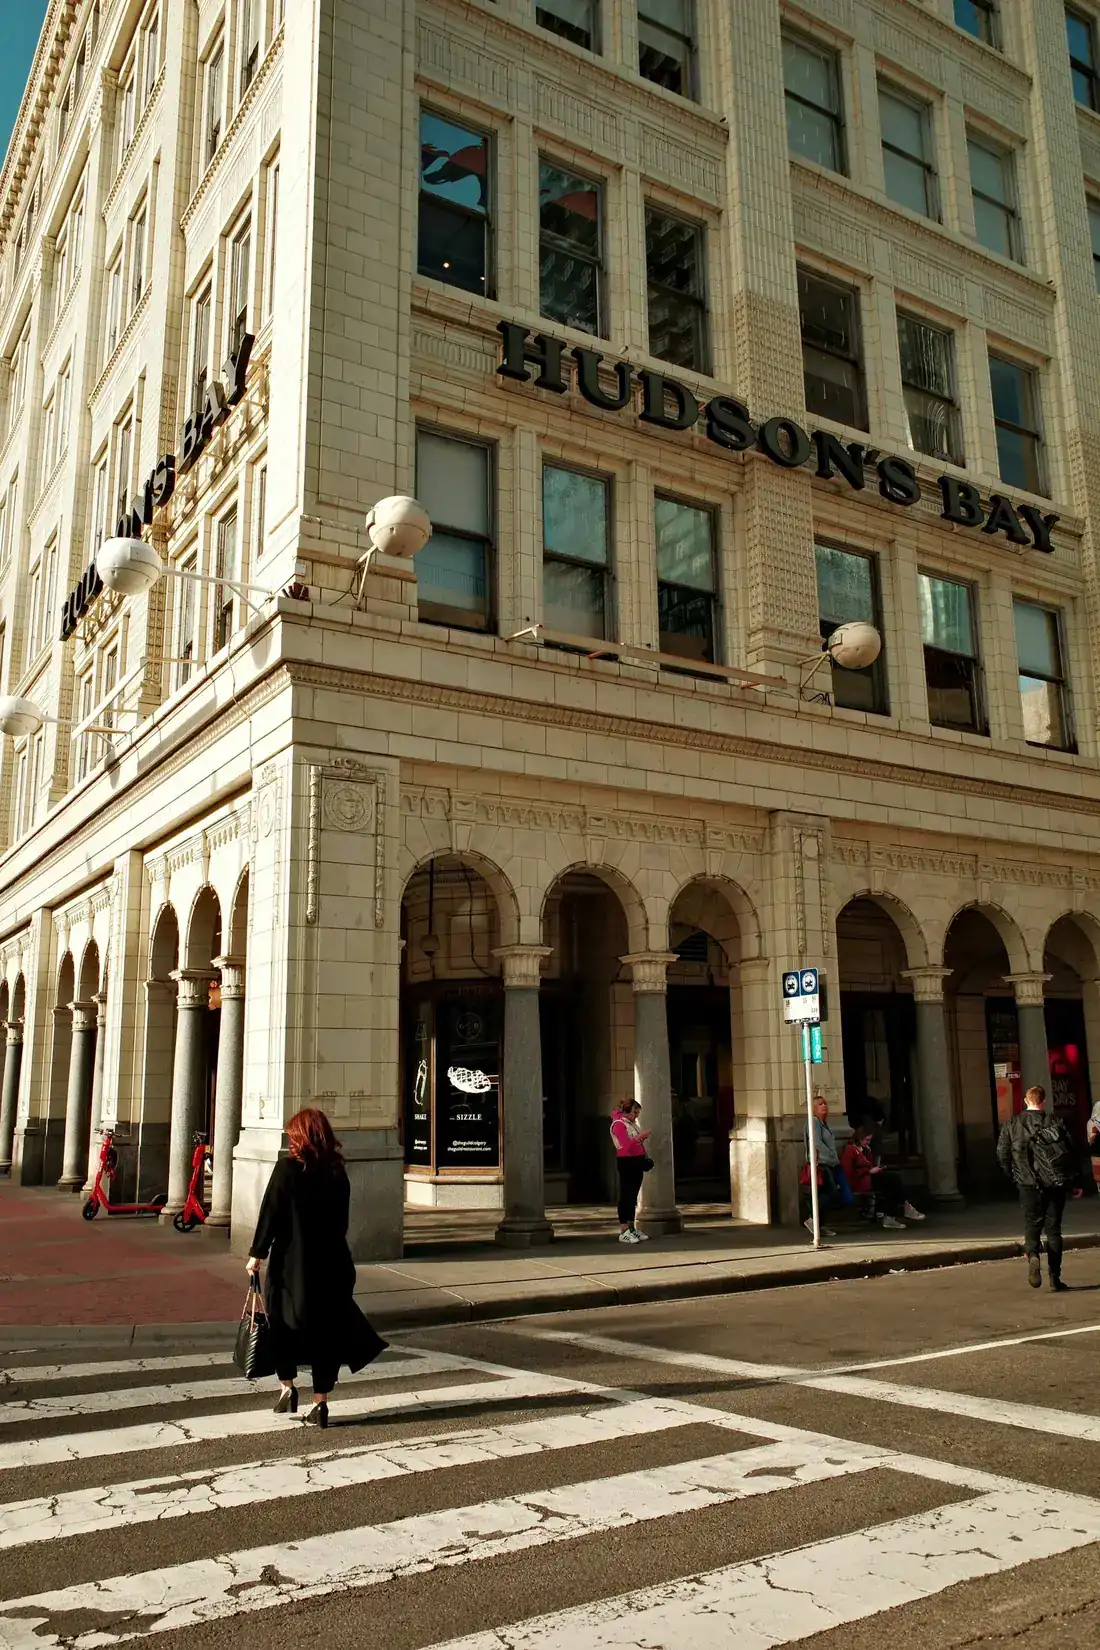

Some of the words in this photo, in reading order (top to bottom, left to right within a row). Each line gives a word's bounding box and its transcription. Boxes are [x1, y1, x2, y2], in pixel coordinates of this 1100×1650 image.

[178, 333, 256, 475] BAY
[497, 320, 922, 505] HUDSON'S
[937, 475, 1060, 553] BAY
[456, 1113, 483, 1121] SIZZLE
